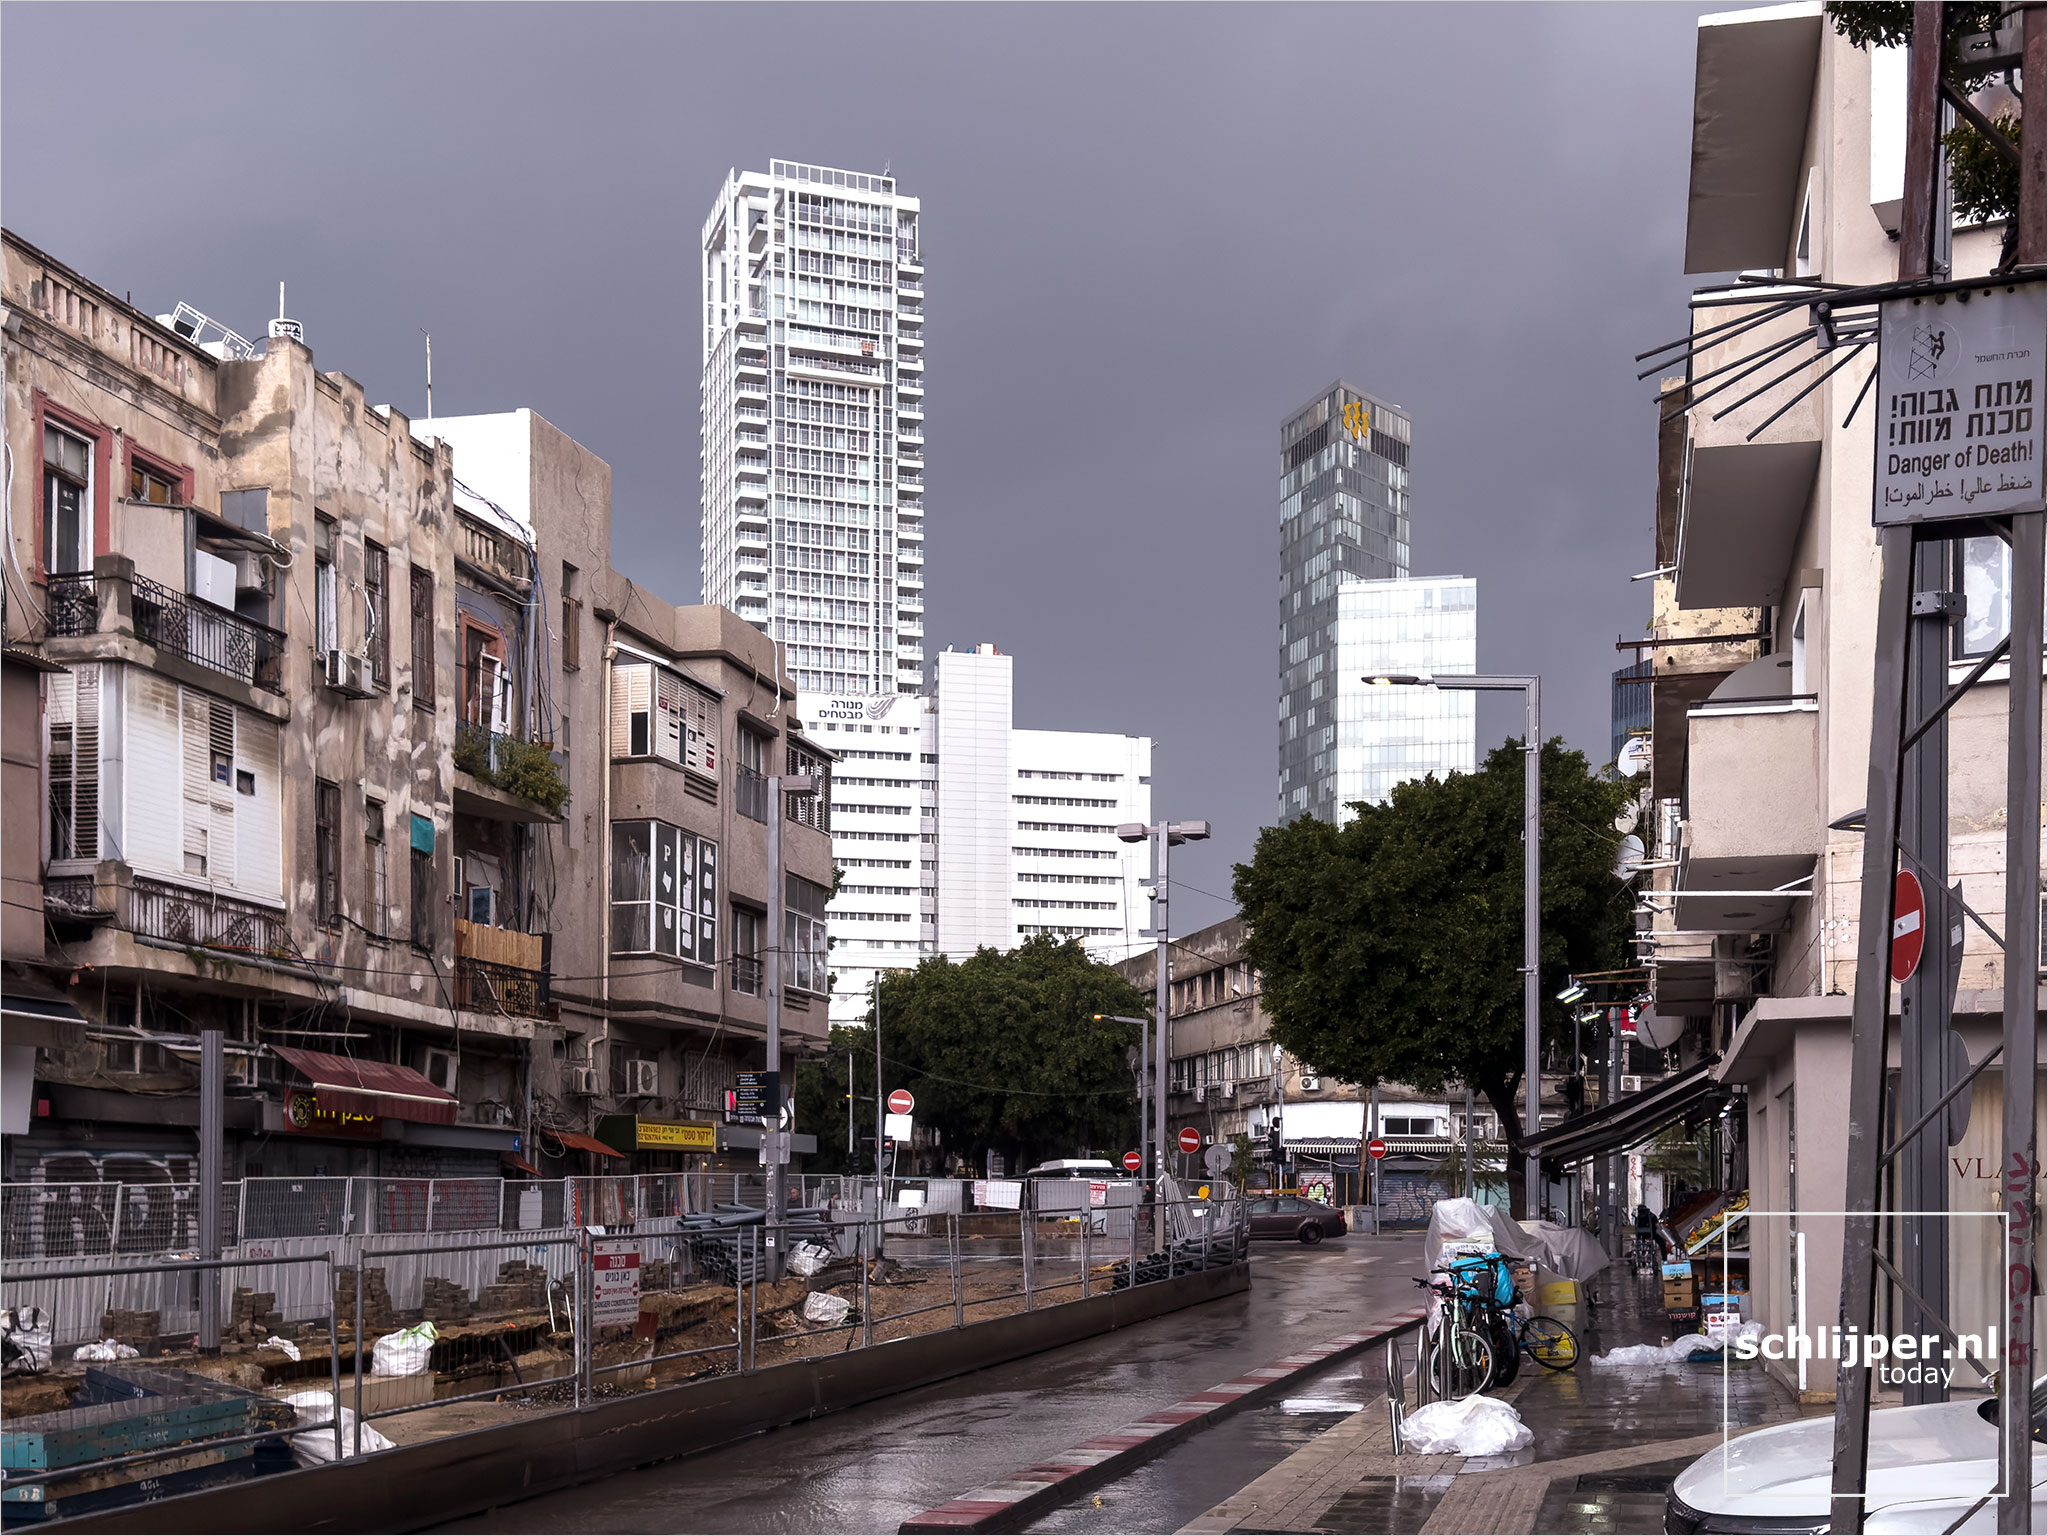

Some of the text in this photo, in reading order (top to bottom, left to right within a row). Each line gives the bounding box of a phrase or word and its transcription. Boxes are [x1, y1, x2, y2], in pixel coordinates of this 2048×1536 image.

[1974, 350, 2030, 363] חברת החשמל
[1891, 379, 2033, 418] מתח גבוה!
[1889, 407, 2033, 446] סכנת מוות!
[1888, 439, 2033, 477] Danger of Death!
[1925, 481, 1954, 505] خطر
[1996, 473, 2033, 492] ضغط
[819, 709, 863, 719] מבטחים
[831, 700, 863, 709] מנורה
